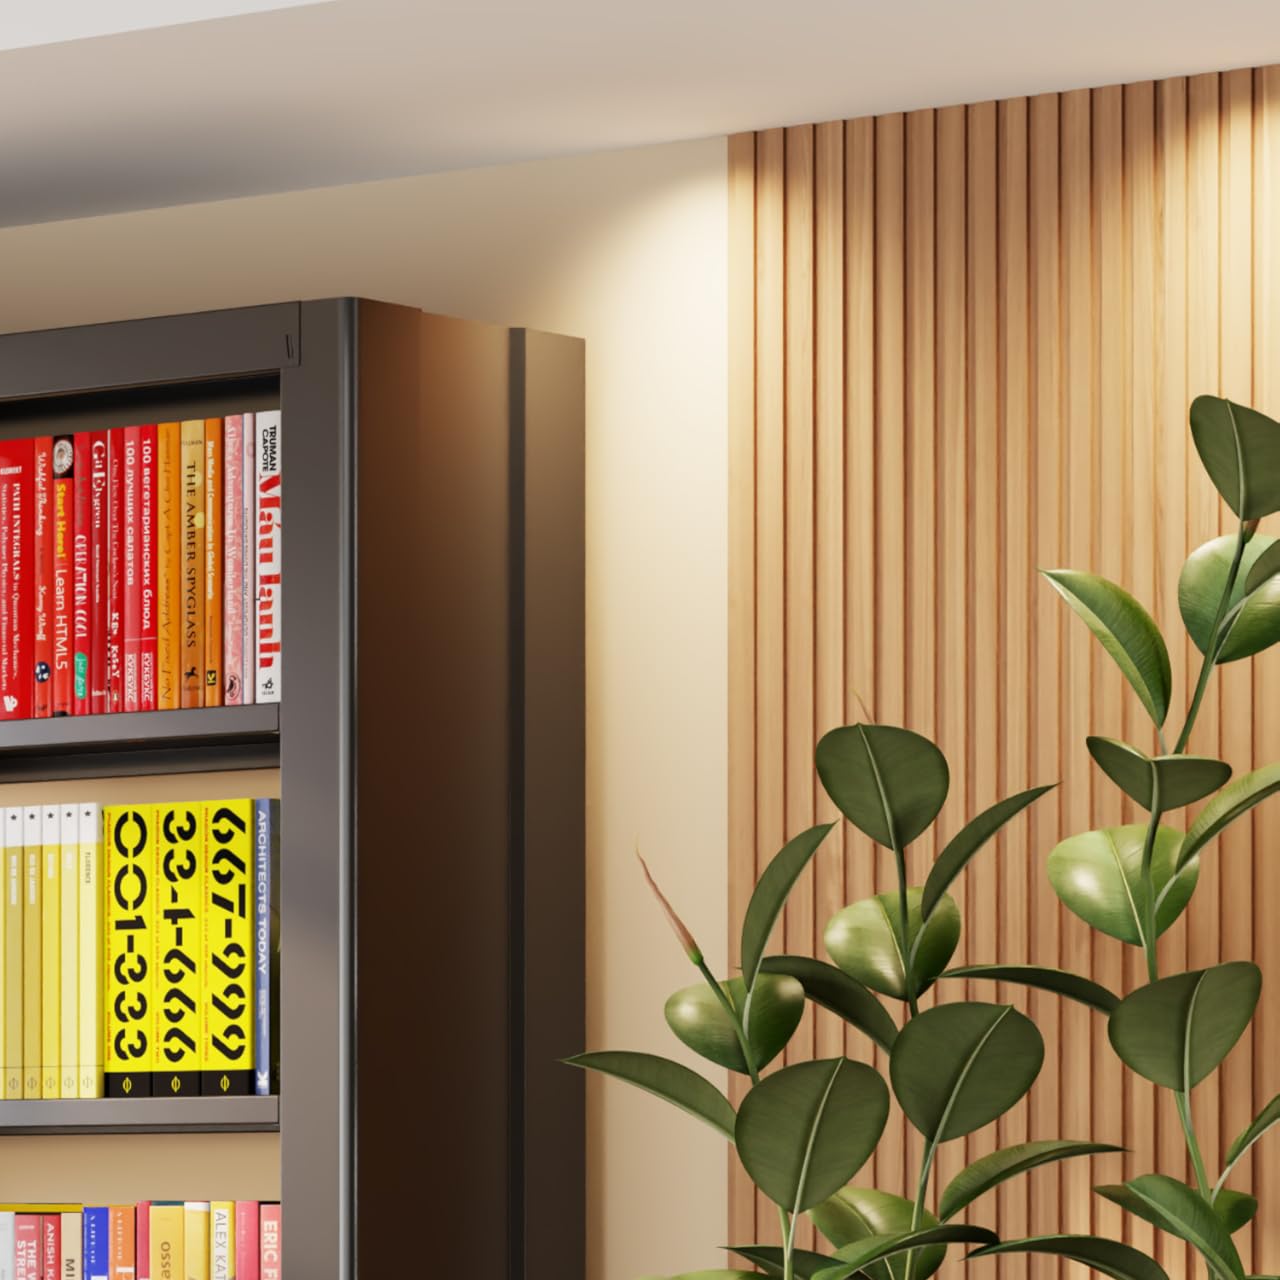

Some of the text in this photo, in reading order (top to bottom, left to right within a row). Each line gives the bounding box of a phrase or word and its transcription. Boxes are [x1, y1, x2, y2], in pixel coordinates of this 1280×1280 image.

[125, 440, 136, 466] 100
[141, 438, 153, 464] 100
[269, 425, 277, 472] TRUMAN
[12, 482, 21, 511] PATH
[56, 484, 67, 517] Start
[125, 468, 136, 525] лучших
[12, 514, 21, 580] INTEGRALS
[141, 467, 153, 586] вегетарианских
[75, 535, 88, 606] OPERATION
[125, 527, 136, 586] салатов
[185, 461, 197, 648] THE AMBER SPYGLASS
[56, 569, 69, 671] Learn HTML5
[75, 609, 88, 641] COOL
[141, 589, 153, 630] блюд
[258, 810, 267, 975] ARCHITECTS TODAY
[211, 807, 247, 1061] 667-999
[47, 1223, 55, 1264] ANISH
[215, 1212, 227, 1249] ALEX
[264, 1219, 278, 1262] ERIC
[27, 1240, 36, 1267] THE
